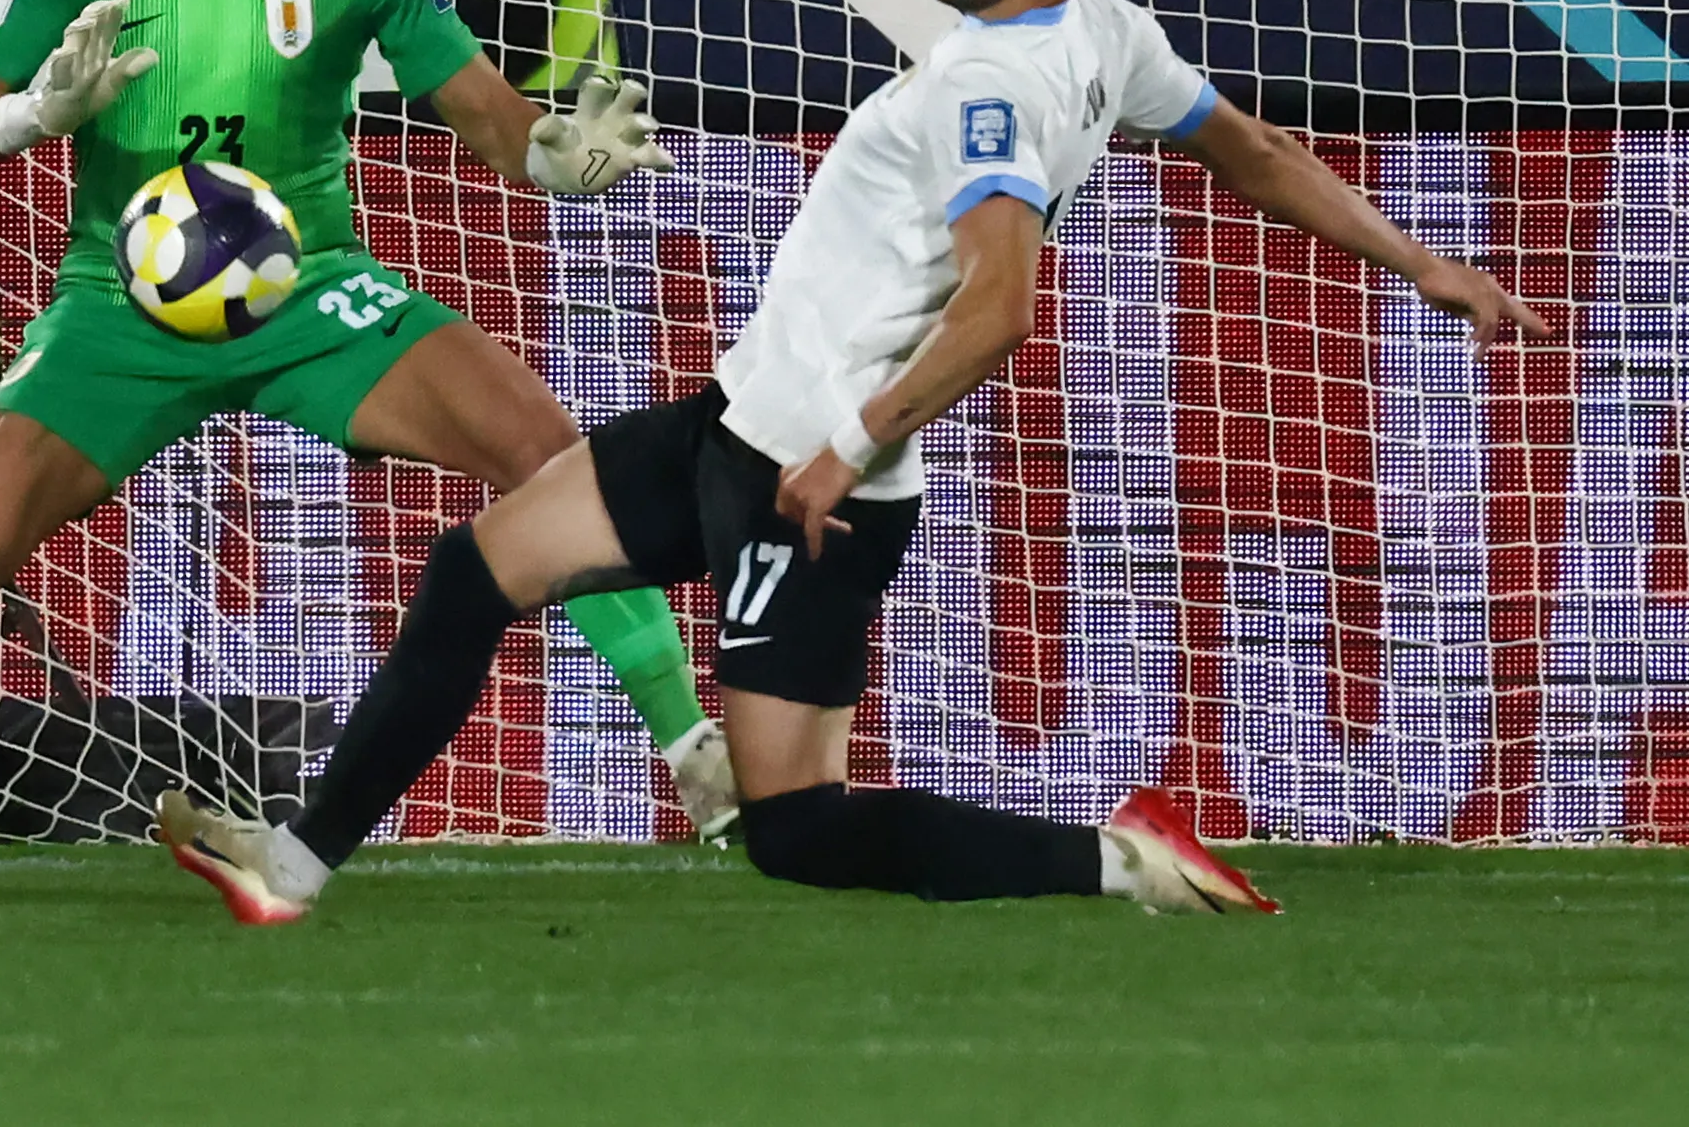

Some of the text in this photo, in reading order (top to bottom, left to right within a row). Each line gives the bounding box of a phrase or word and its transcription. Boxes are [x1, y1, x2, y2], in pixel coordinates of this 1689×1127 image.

[178, 115, 246, 166] 23
[317, 272, 410, 329] 23
[725, 541, 794, 626] 17
